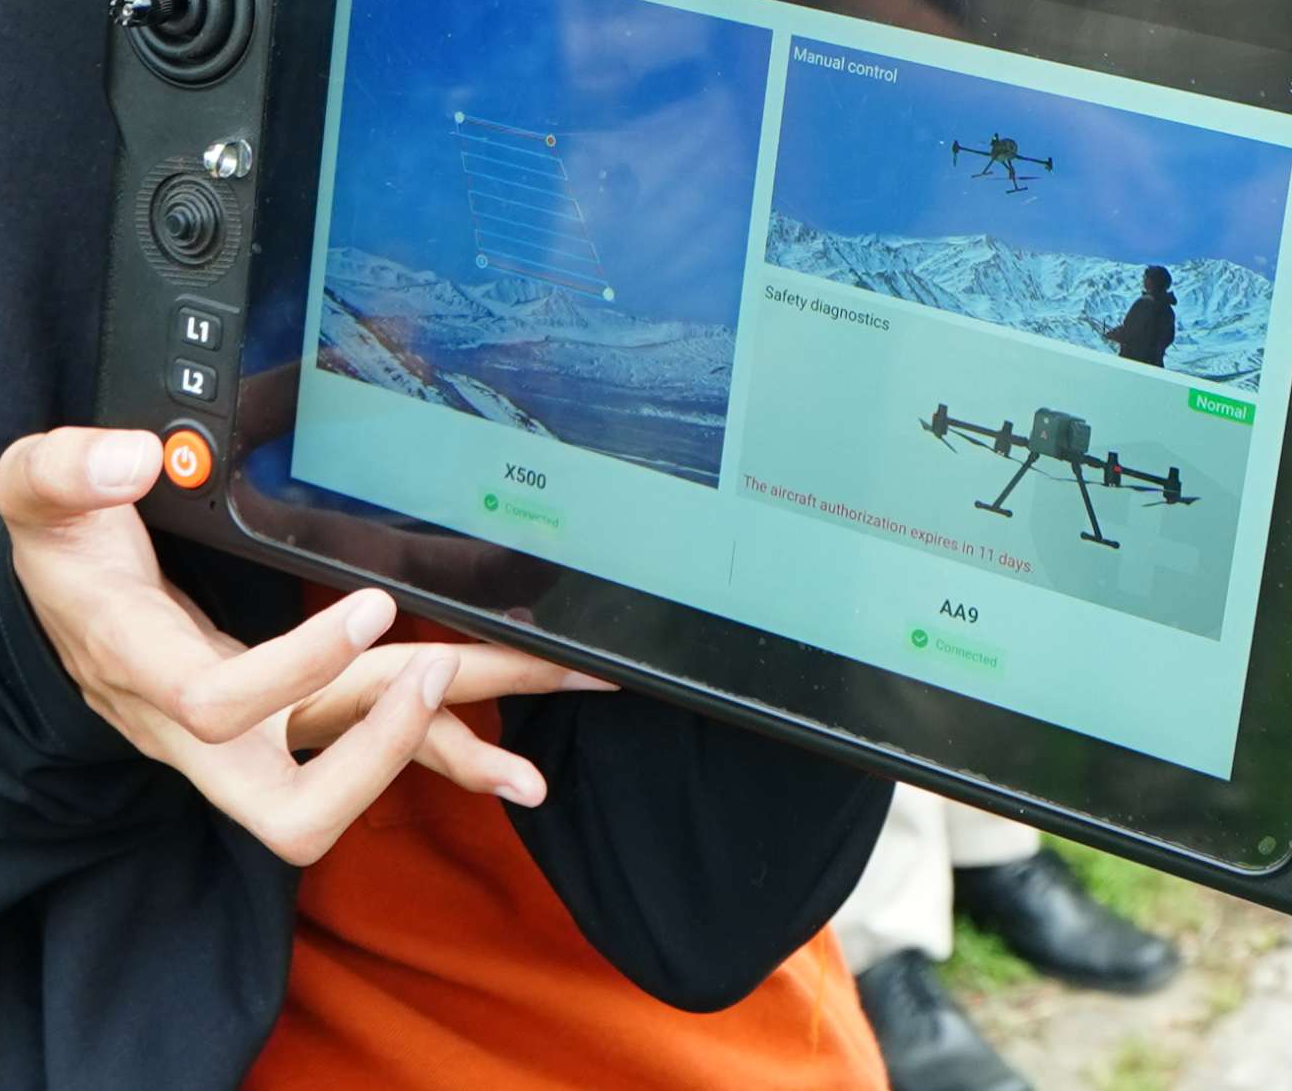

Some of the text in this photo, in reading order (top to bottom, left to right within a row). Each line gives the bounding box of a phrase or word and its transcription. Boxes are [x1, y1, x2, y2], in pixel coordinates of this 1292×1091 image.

[793, 46, 898, 84] Manual control
[764, 284, 891, 331] Safety diagnostics
[187, 316, 210, 343] L1
[182, 368, 204, 395] L2
[1196, 394, 1248, 420] Normal
[504, 462, 547, 490] X500
[743, 474, 768, 493] The
[770, 485, 817, 508] aircraft
[819, 499, 907, 536] authorization
[910, 527, 959, 552] expires
[962, 540, 975, 556] in
[979, 545, 995, 562] 11
[939, 598, 979, 624] AA9
[935, 638, 998, 669] Connected
